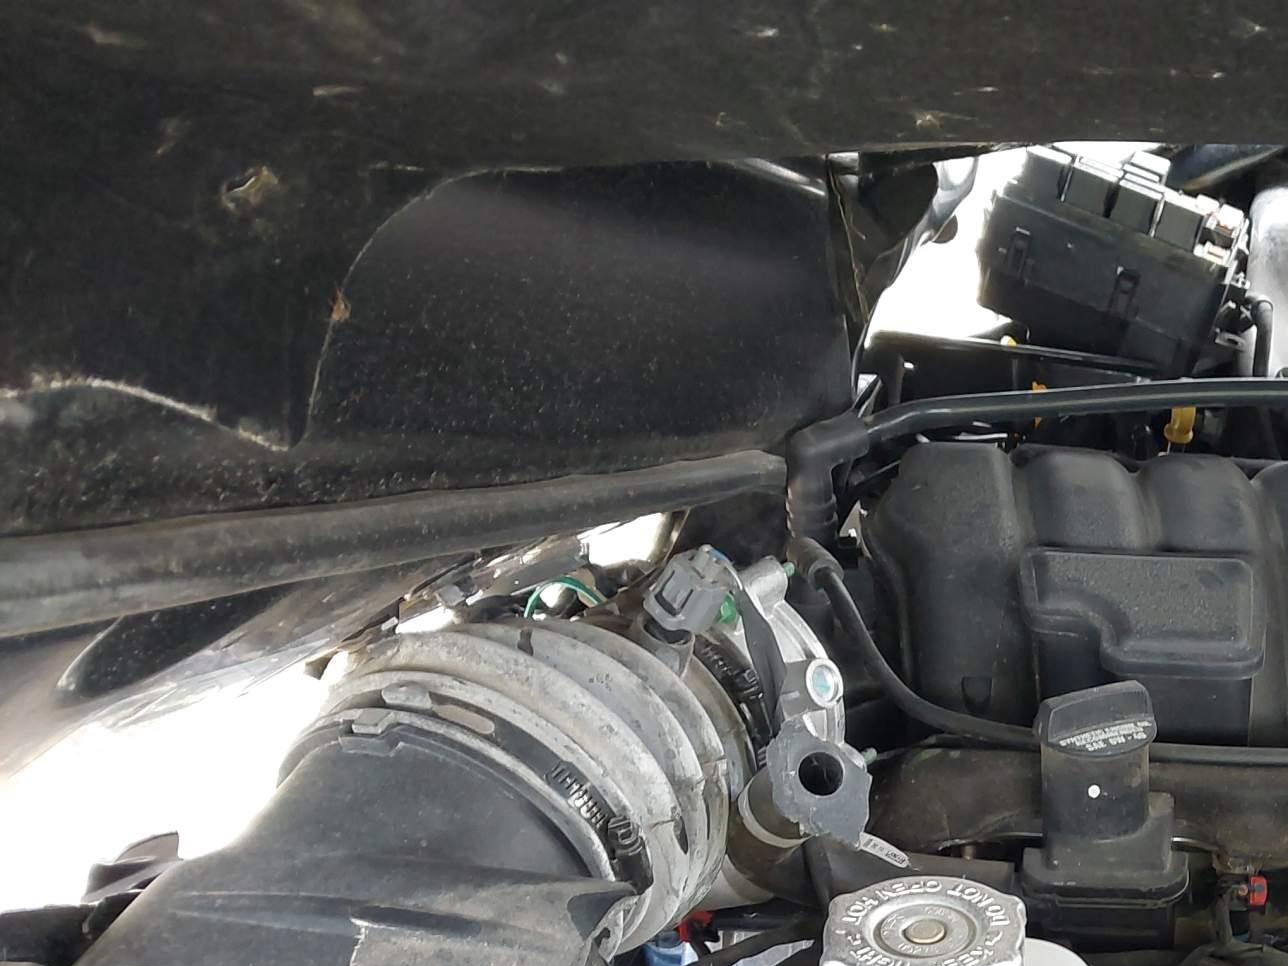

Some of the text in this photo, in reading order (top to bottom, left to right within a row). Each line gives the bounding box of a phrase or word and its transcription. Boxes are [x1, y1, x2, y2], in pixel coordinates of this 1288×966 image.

[875, 880, 943, 901] OPEN
[946, 881, 990, 908] NOT
[841, 896, 879, 926] HOT
[988, 902, 1011, 926] DO
